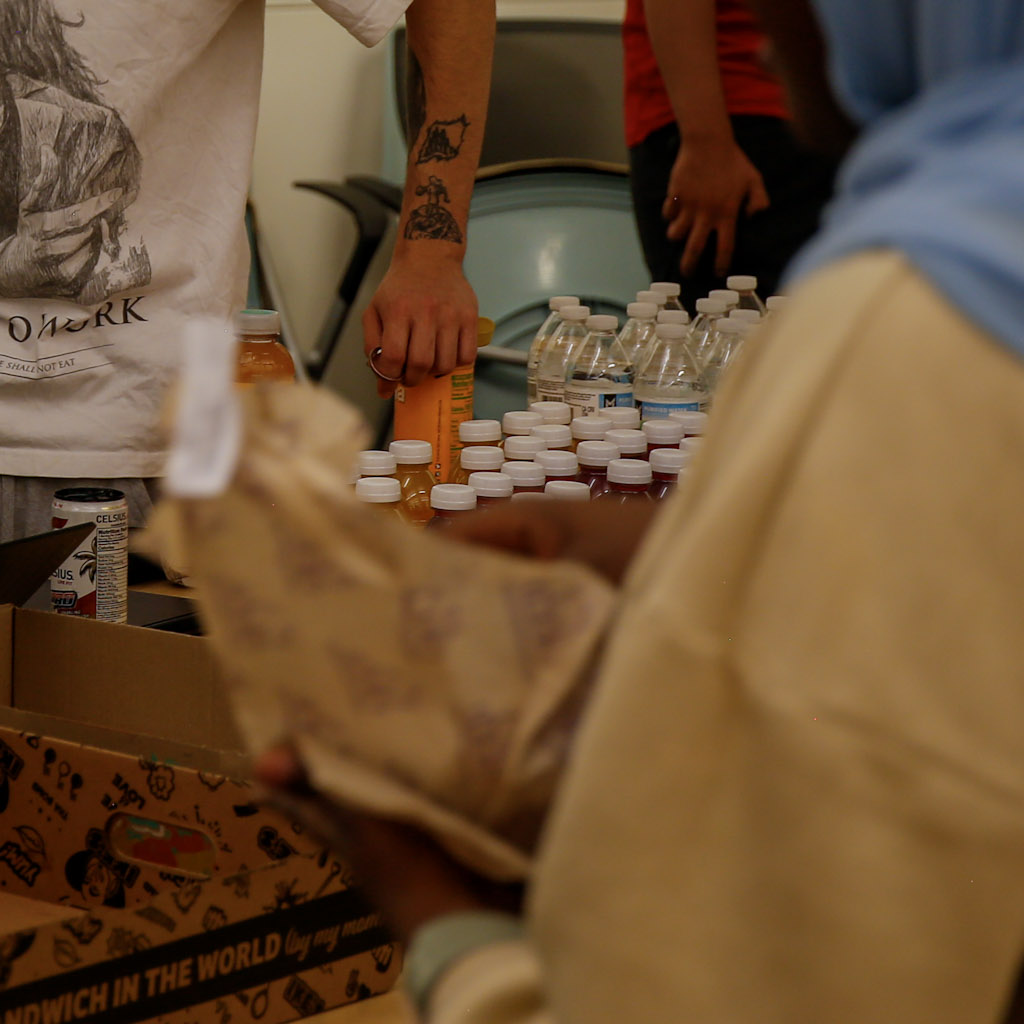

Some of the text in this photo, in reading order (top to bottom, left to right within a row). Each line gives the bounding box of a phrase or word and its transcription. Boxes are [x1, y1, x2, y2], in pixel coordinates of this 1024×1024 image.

[6, 362, 37, 374] SHALL
[37, 364, 57, 375] NOT
[58, 358, 76, 370] EAT
[96, 513, 127, 523] CELSIUS
[111, 968, 142, 1008] IN
[143, 955, 194, 999] THE
[194, 931, 284, 986] WORLD
[312, 922, 341, 953] my
